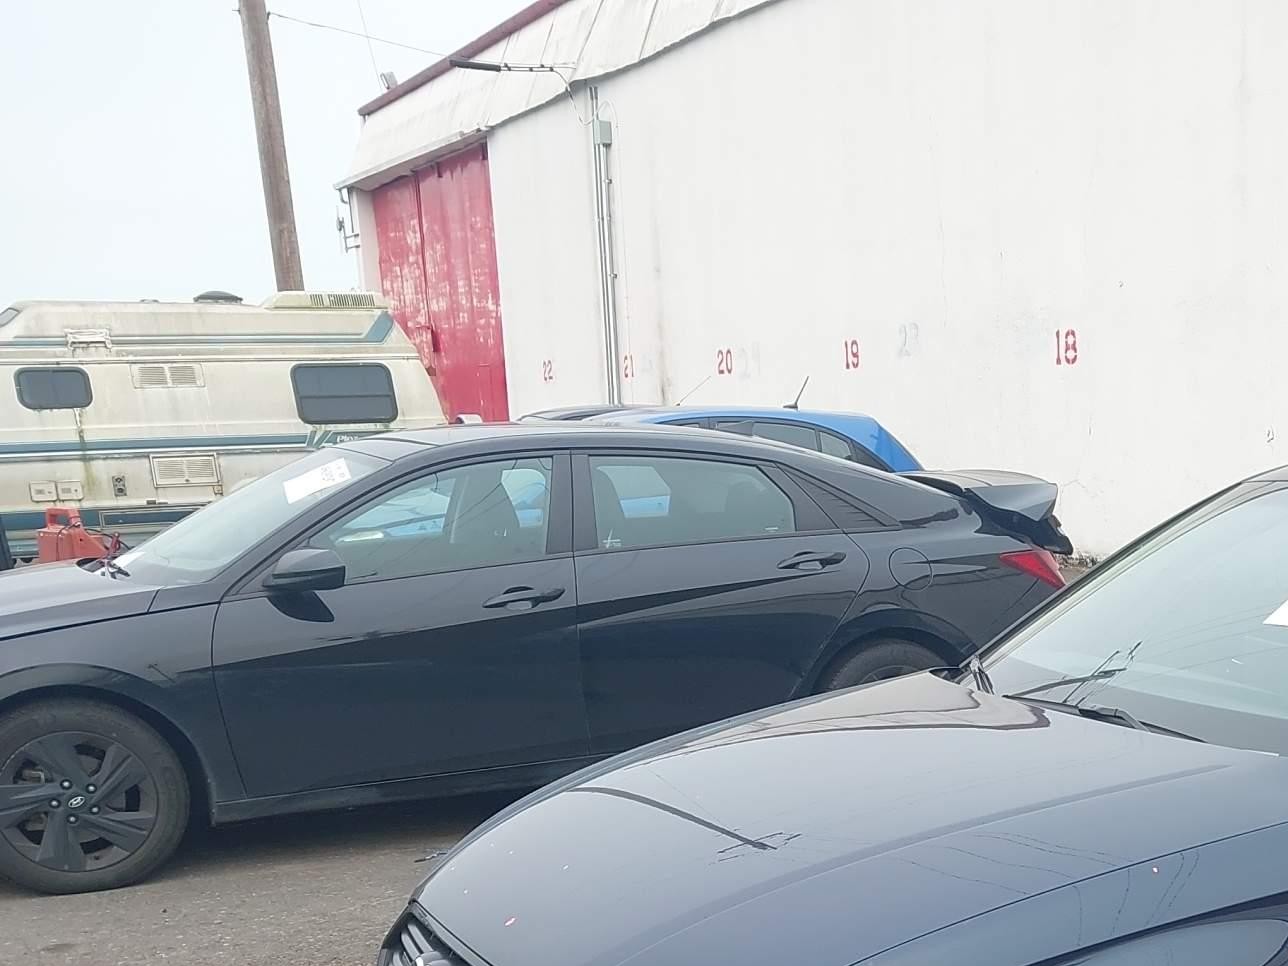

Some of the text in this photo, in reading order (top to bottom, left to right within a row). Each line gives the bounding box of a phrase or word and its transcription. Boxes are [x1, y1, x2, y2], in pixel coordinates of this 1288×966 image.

[844, 339, 860, 370] 19
[1055, 328, 1077, 365] 18
[542, 359, 554, 381] 22
[623, 353, 635, 379] 21
[717, 348, 733, 375] 20
